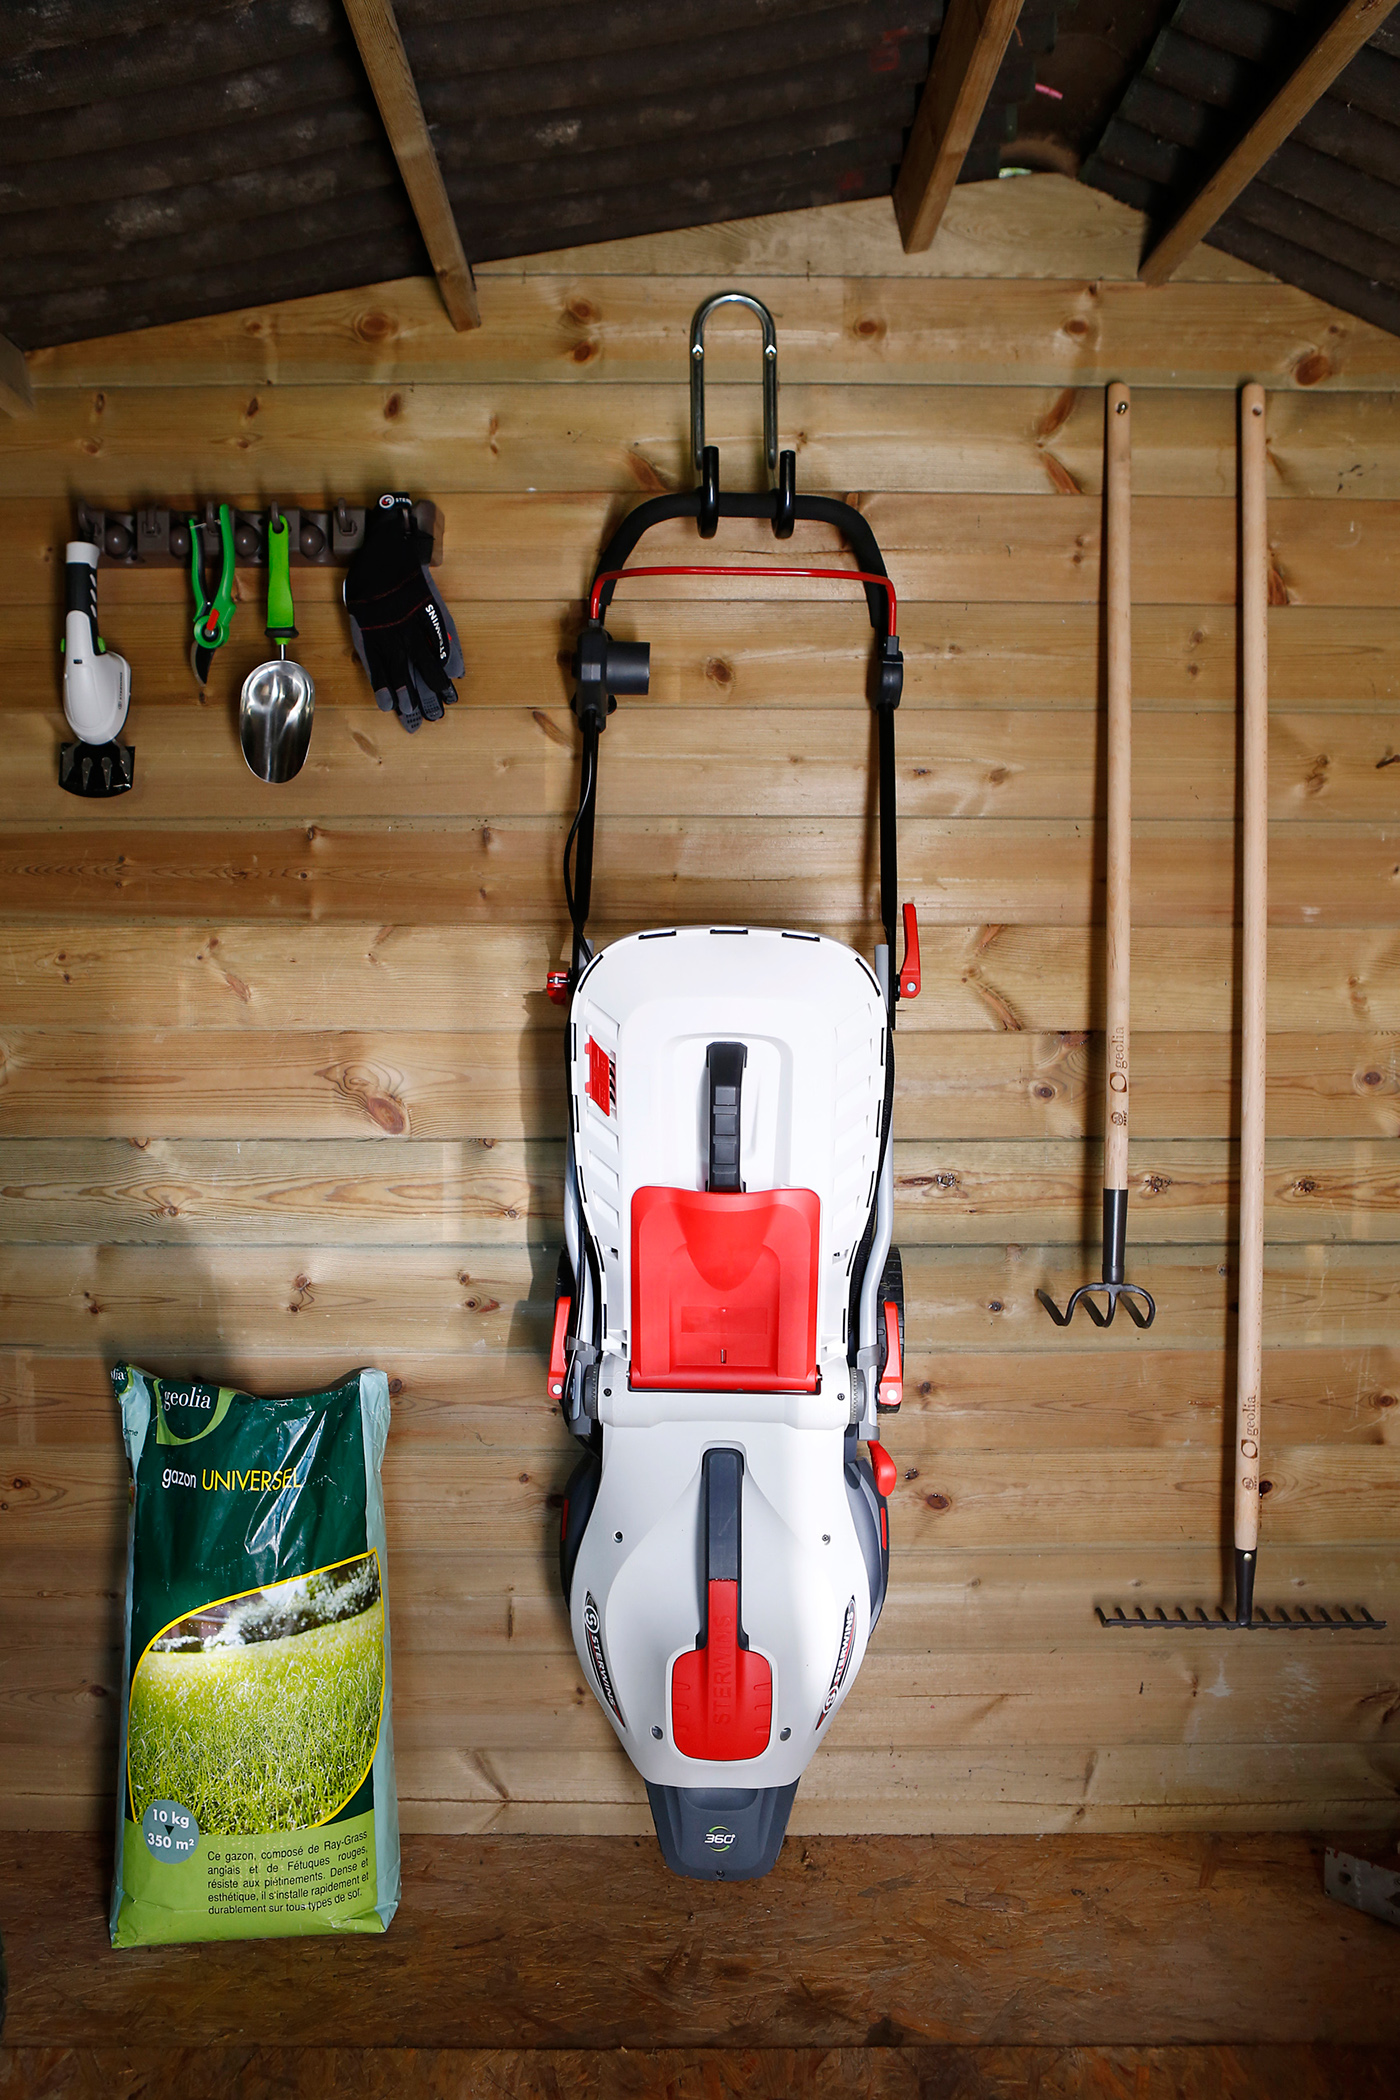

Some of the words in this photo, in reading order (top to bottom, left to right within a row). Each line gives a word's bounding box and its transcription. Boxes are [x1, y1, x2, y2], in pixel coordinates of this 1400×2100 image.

[1112, 1027, 1128, 1069] geolia
[164, 1386, 211, 1411] geolia
[1242, 1395, 1259, 1436] geolia
[161, 1468, 197, 1489] gazon
[202, 1467, 303, 1491] UNIVERSEL
[834, 1611, 854, 1686] STERWINS
[591, 1635, 616, 1706] STERWINS
[713, 1616, 732, 1724] STERWINS
[153, 1808, 168, 1823] 10
[171, 1811, 189, 1829] kg
[147, 1832, 172, 1849] 350
[207, 1850, 221, 1861] Ce
[225, 1852, 257, 1863] gazon,
[261, 1846, 304, 1861] composé
[308, 1844, 319, 1854] de
[324, 1831, 368, 1851] Ray-Grass
[207, 1865, 241, 1877] anglais
[249, 1864, 259, 1874] et
[266, 1863, 279, 1873] de
[287, 1857, 330, 1872] Fétuques
[338, 1846, 368, 1861] rouges,
[207, 1879, 239, 1889] résiste
[243, 1880, 260, 1888] aux
[264, 1872, 326, 1888] piétinements.
[330, 1863, 358, 1878] Dense
[361, 1857, 369, 1868] et
[208, 1892, 259, 1903] esthétique,
[261, 1890, 267, 1900] il
[268, 1888, 309, 1900] s'installe
[311, 1875, 360, 1896] rapidement
[361, 1871, 369, 1882] et
[208, 1905, 266, 1915] durablement
[268, 1904, 283, 1912] sur
[286, 1903, 306, 1912] tous
[308, 1897, 333, 1912] types
[334, 1893, 346, 1904] de
[347, 1887, 363, 1900] sol.
